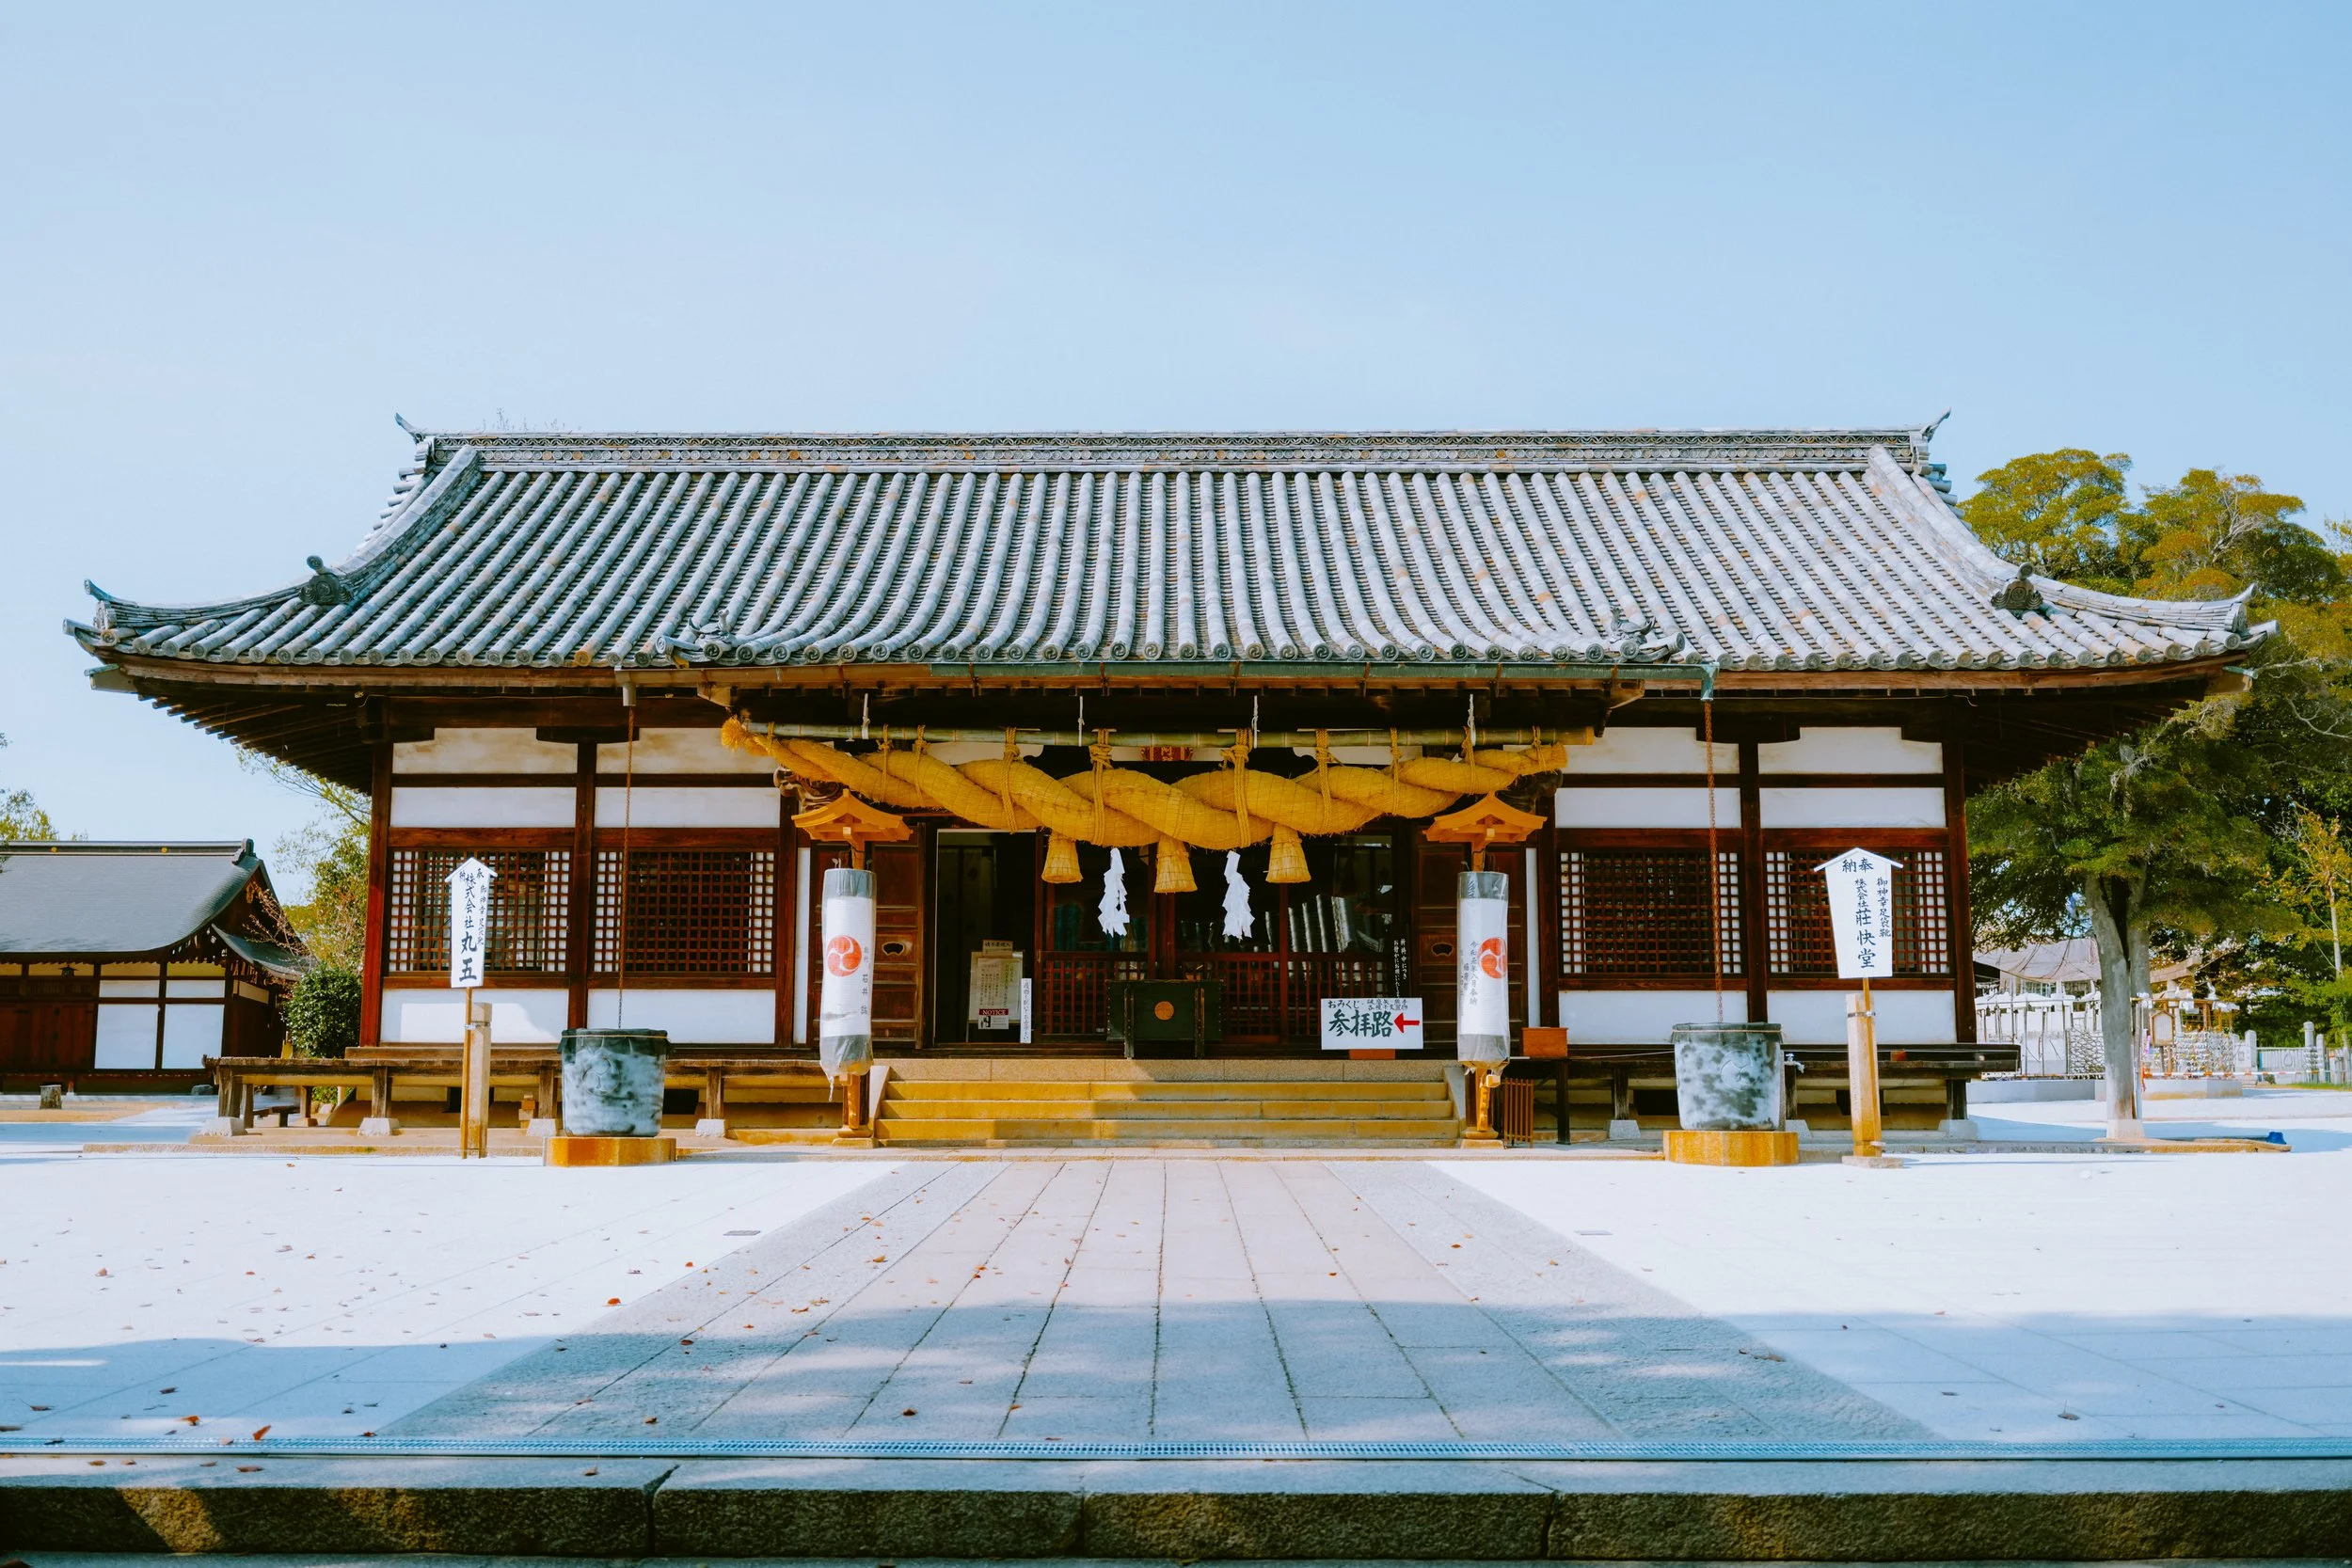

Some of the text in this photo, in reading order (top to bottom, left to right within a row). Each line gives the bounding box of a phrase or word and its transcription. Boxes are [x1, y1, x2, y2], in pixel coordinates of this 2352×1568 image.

[1842, 858, 1874, 873] 奉納
[458, 872, 477, 982] 株式会社丸五
[1877, 877, 1892, 938] 御神幸足袋靴
[1328, 1009, 1393, 1037] 参拝路
